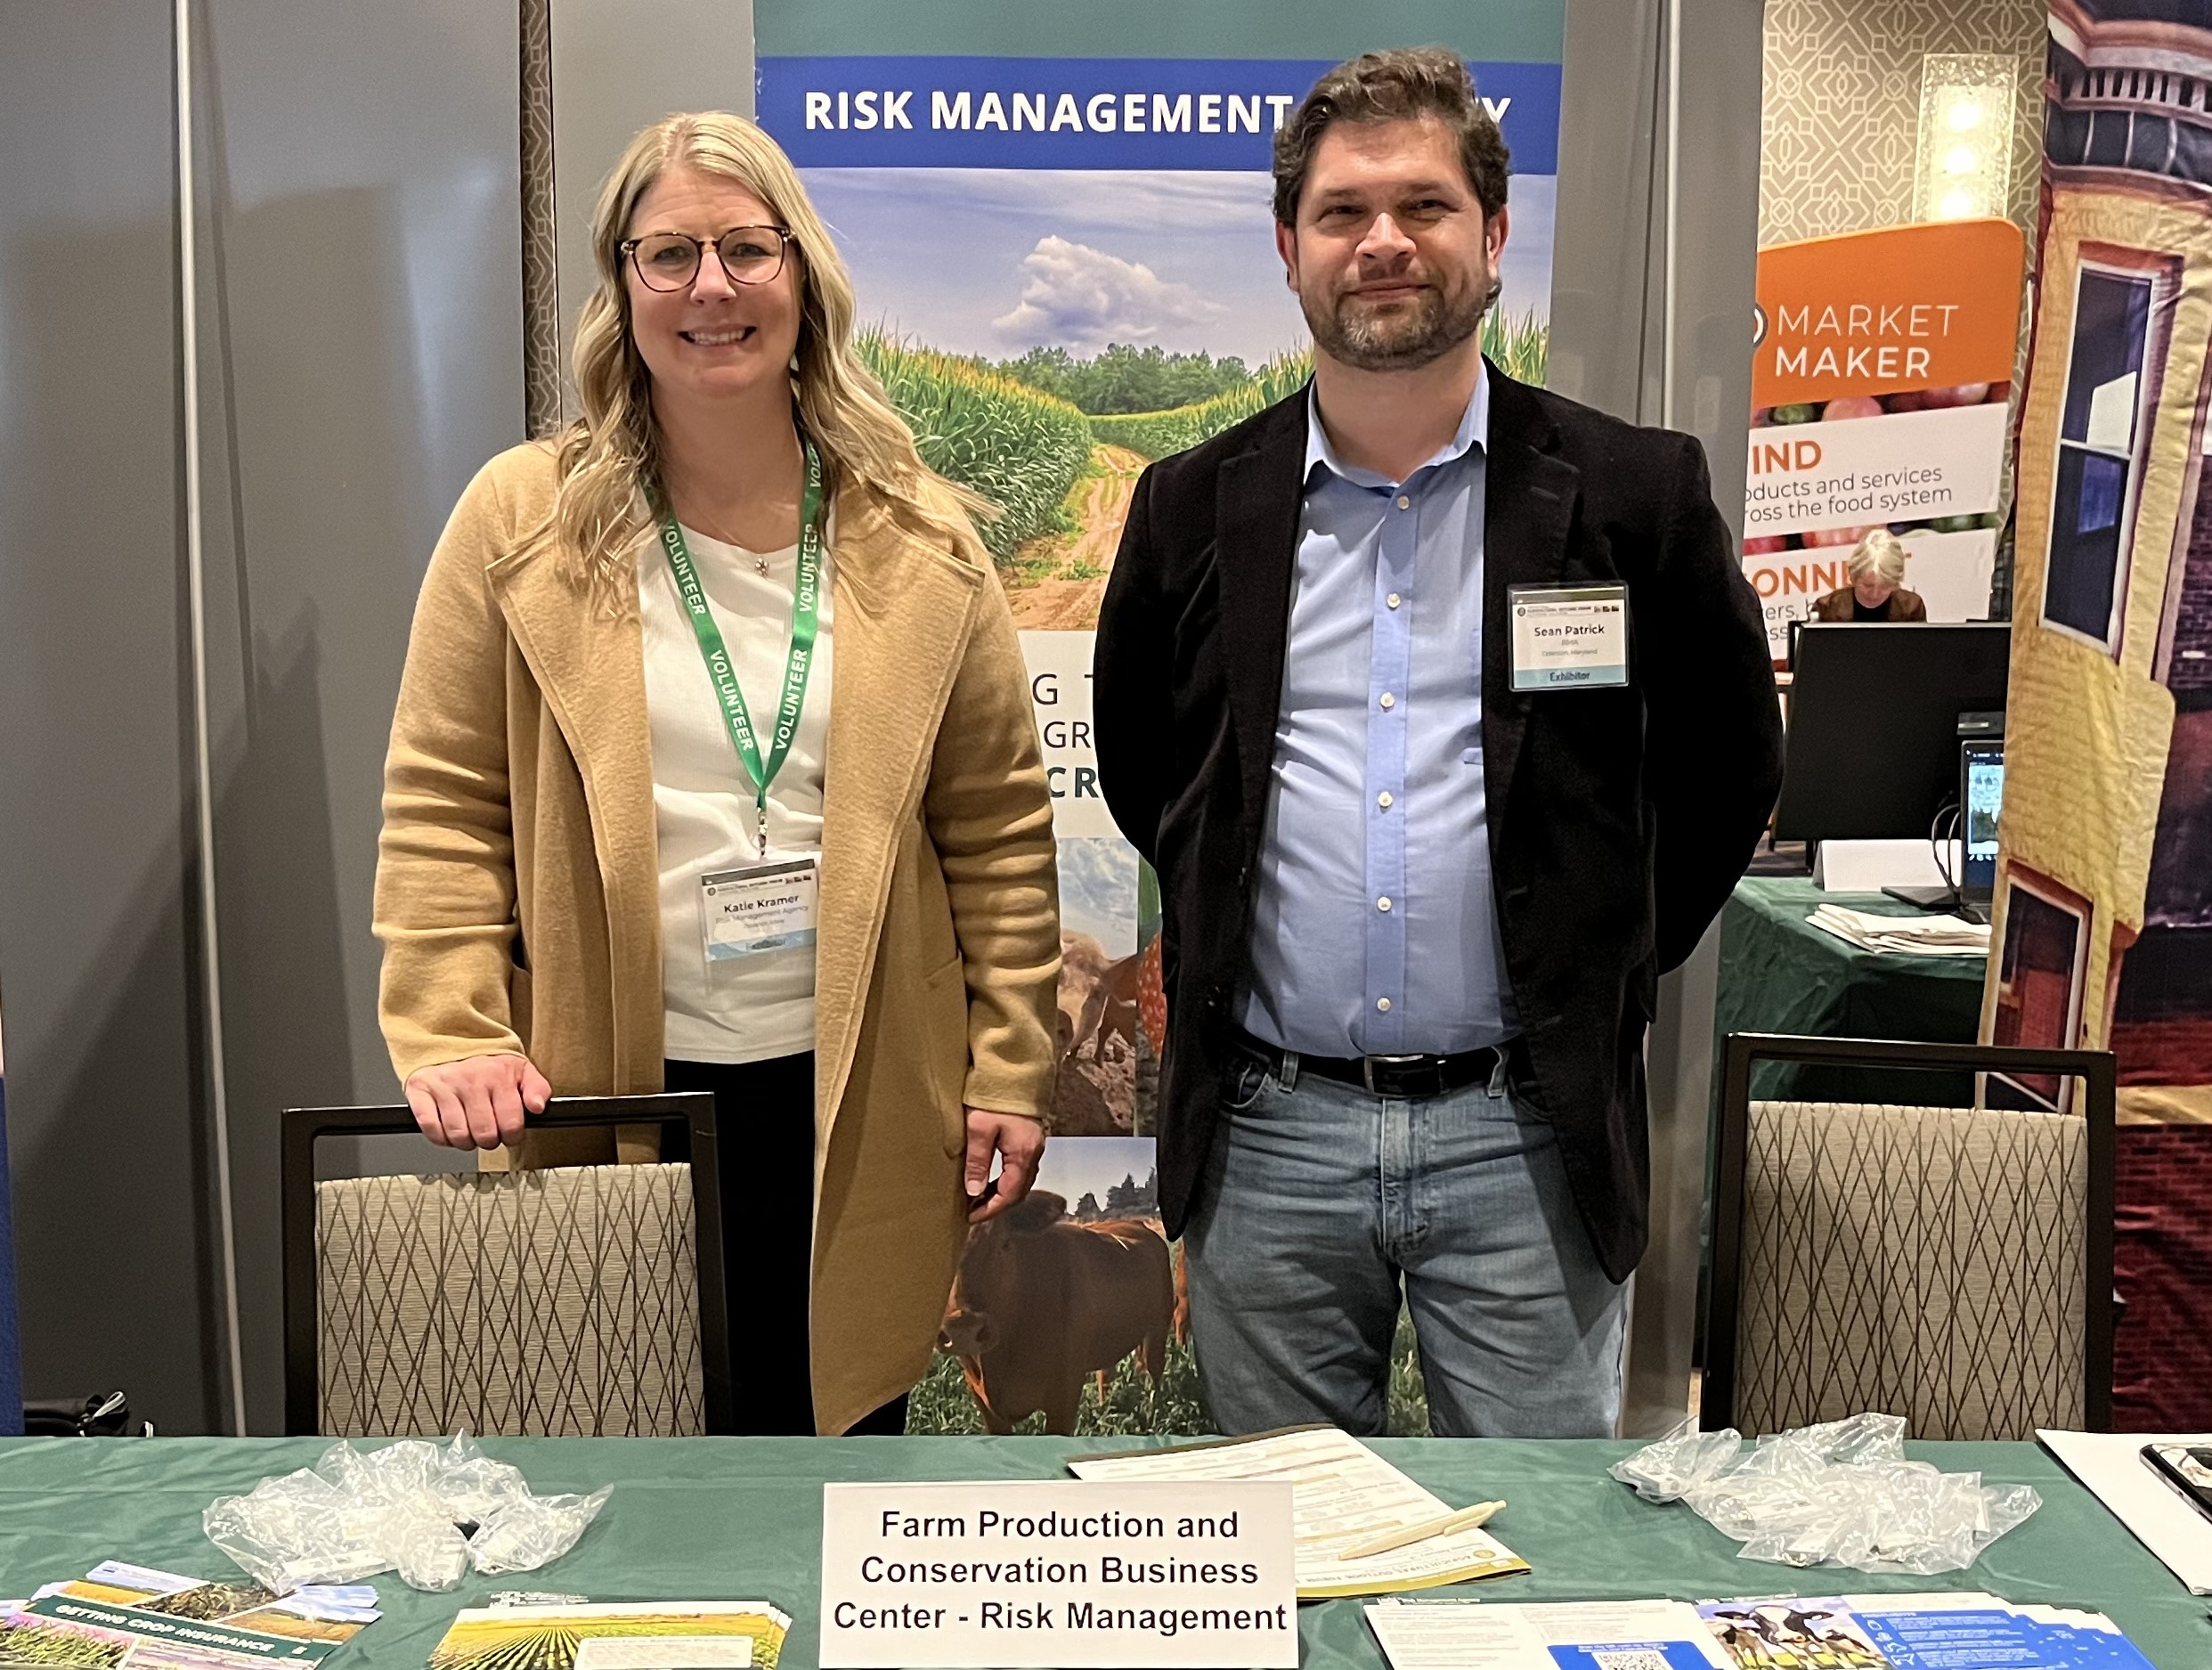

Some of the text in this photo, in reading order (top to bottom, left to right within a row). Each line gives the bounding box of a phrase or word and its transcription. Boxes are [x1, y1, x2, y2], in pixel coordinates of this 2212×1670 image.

[805, 91, 1293, 134] RISK MANAGEMENT
[1777, 305, 1959, 337] MARKET
[1776, 346, 1931, 378] MAKER
[1753, 441, 1822, 475] IND
[1745, 467, 1943, 502] oducts and services
[1745, 487, 1952, 524] oss the food system
[1765, 602, 1799, 621] ers,
[1534, 624, 1605, 637] Sean Patrick
[1549, 672, 1590, 681] Exhibitor
[711, 649, 755, 751] VOLUNTEER
[776, 648, 808, 751] VOLUNTEER
[724, 895, 800, 913] Katie Kramer
[882, 1511, 1238, 1538] Farm Production and
[861, 1556, 1258, 1584] Conservation Business
[55, 1603, 274, 1653] GETTING CROP INSURANCE
[834, 1601, 947, 1629] Center
[981, 1601, 1053, 1629] Risk
[1068, 1602, 1288, 1637] Management
